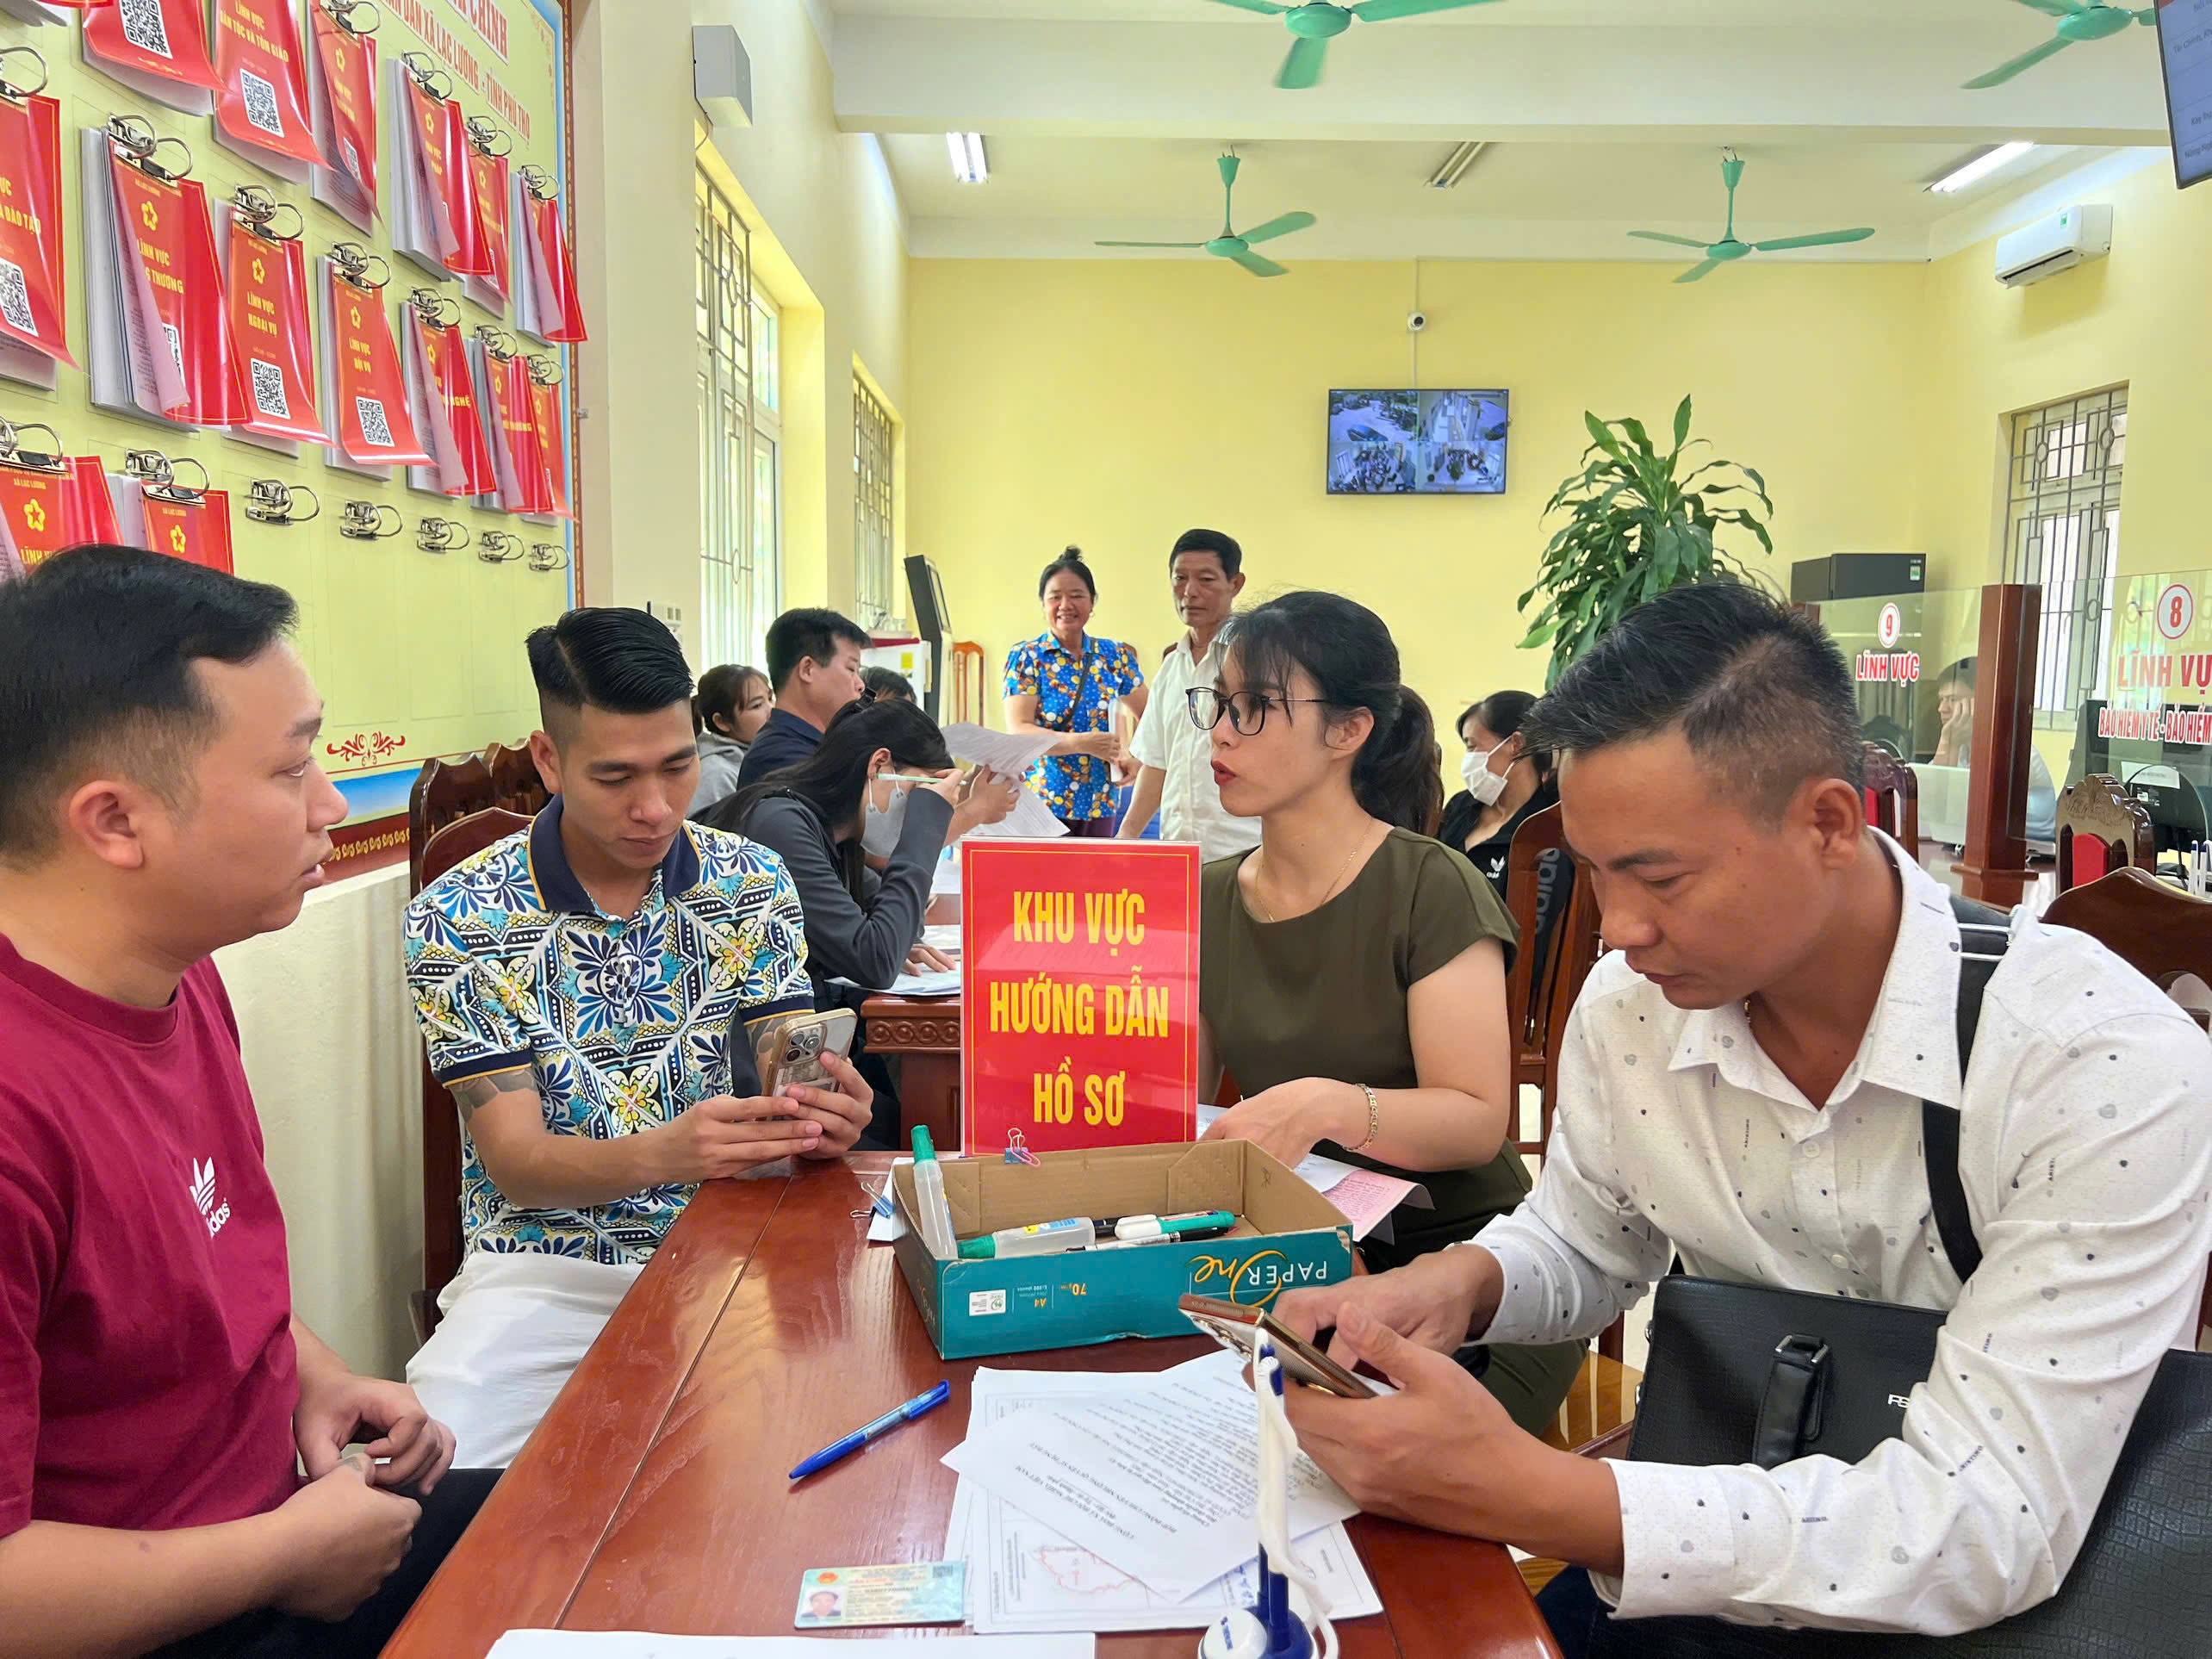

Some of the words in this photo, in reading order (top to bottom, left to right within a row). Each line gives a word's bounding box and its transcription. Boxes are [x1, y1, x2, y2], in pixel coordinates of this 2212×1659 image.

[424, 9, 435, 49] XÃ
[437, 22, 452, 66] LẠC
[1886, 613, 1893, 637] 9
[2170, 596, 2183, 628] 8
[1855, 651, 1888, 680] LĨNH
[1891, 652, 1920, 686] VỰC
[2117, 648, 2173, 687] LĨNH
[2166, 705, 2185, 742] BẢO
[1013, 891, 1075, 944] KHU
[1084, 888, 1146, 956] VỰC
[990, 972, 1096, 1035] HƯỚNG
[1105, 965, 1169, 1039] DẪN
[1034, 1056, 1074, 1124] HỒ
[1084, 1071, 1127, 1127] SƠ
[1184, 1249, 1289, 1308] One
[1246, 1260, 1327, 1285] PAPER
